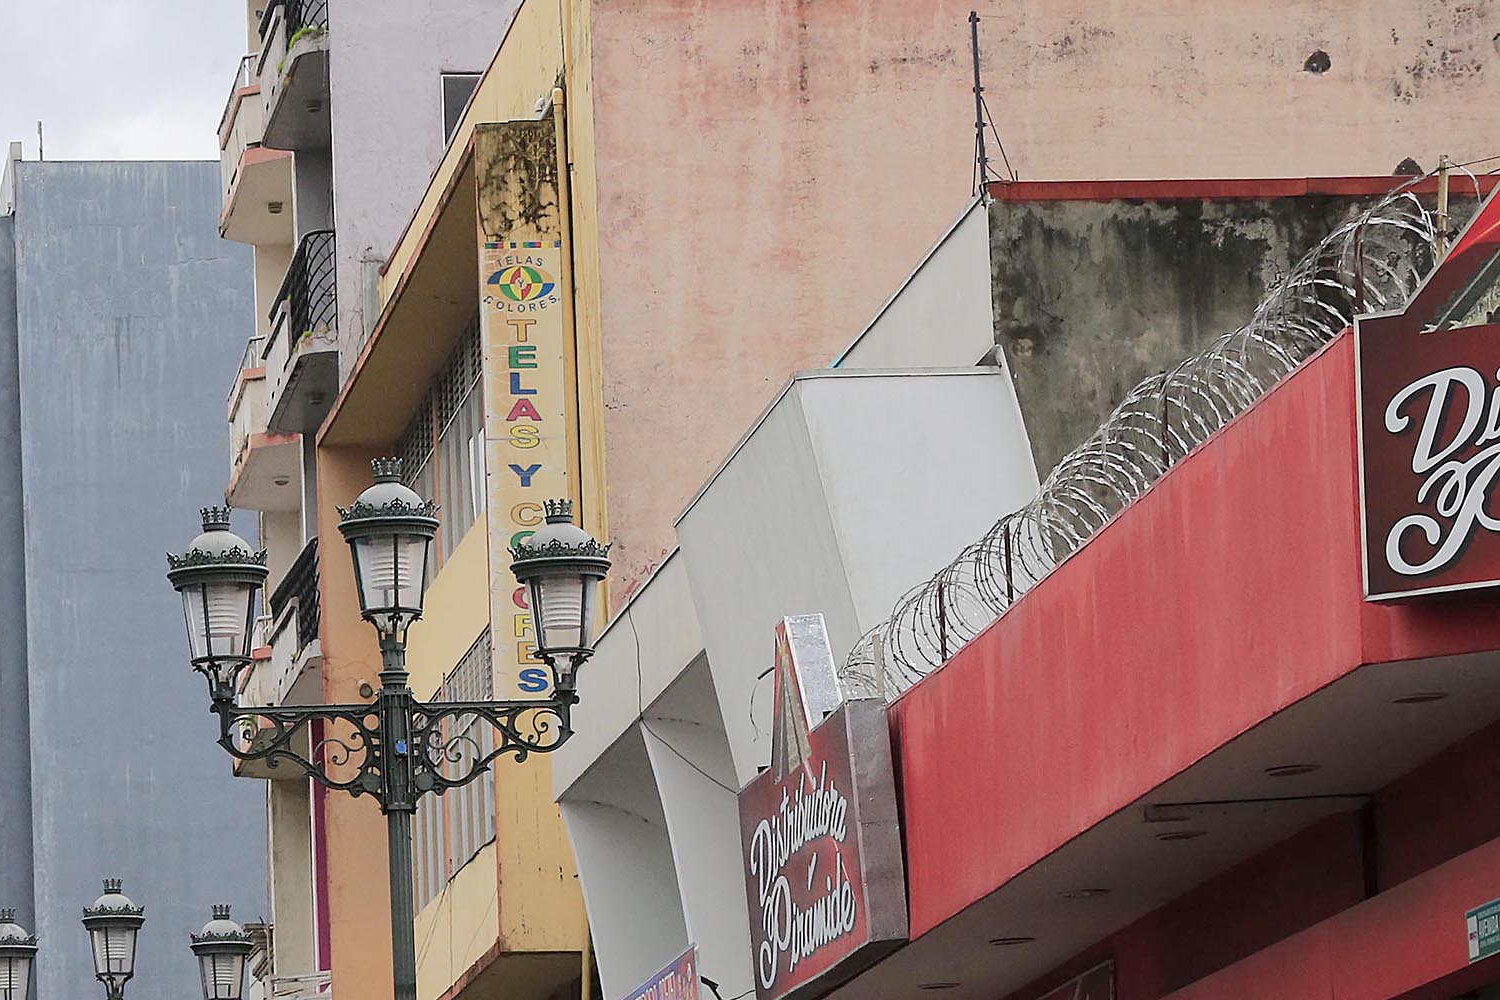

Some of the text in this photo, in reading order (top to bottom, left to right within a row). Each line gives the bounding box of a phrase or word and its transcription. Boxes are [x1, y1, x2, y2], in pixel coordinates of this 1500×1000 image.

[497, 256, 543, 267] TELAS
[517, 279, 524, 288] Y
[483, 295, 557, 312] COLORES
[506, 319, 543, 449] TELAS
[508, 464, 542, 487] Y
[750, 760, 847, 907] Distribuidora
[759, 852, 856, 989] Pirámide
